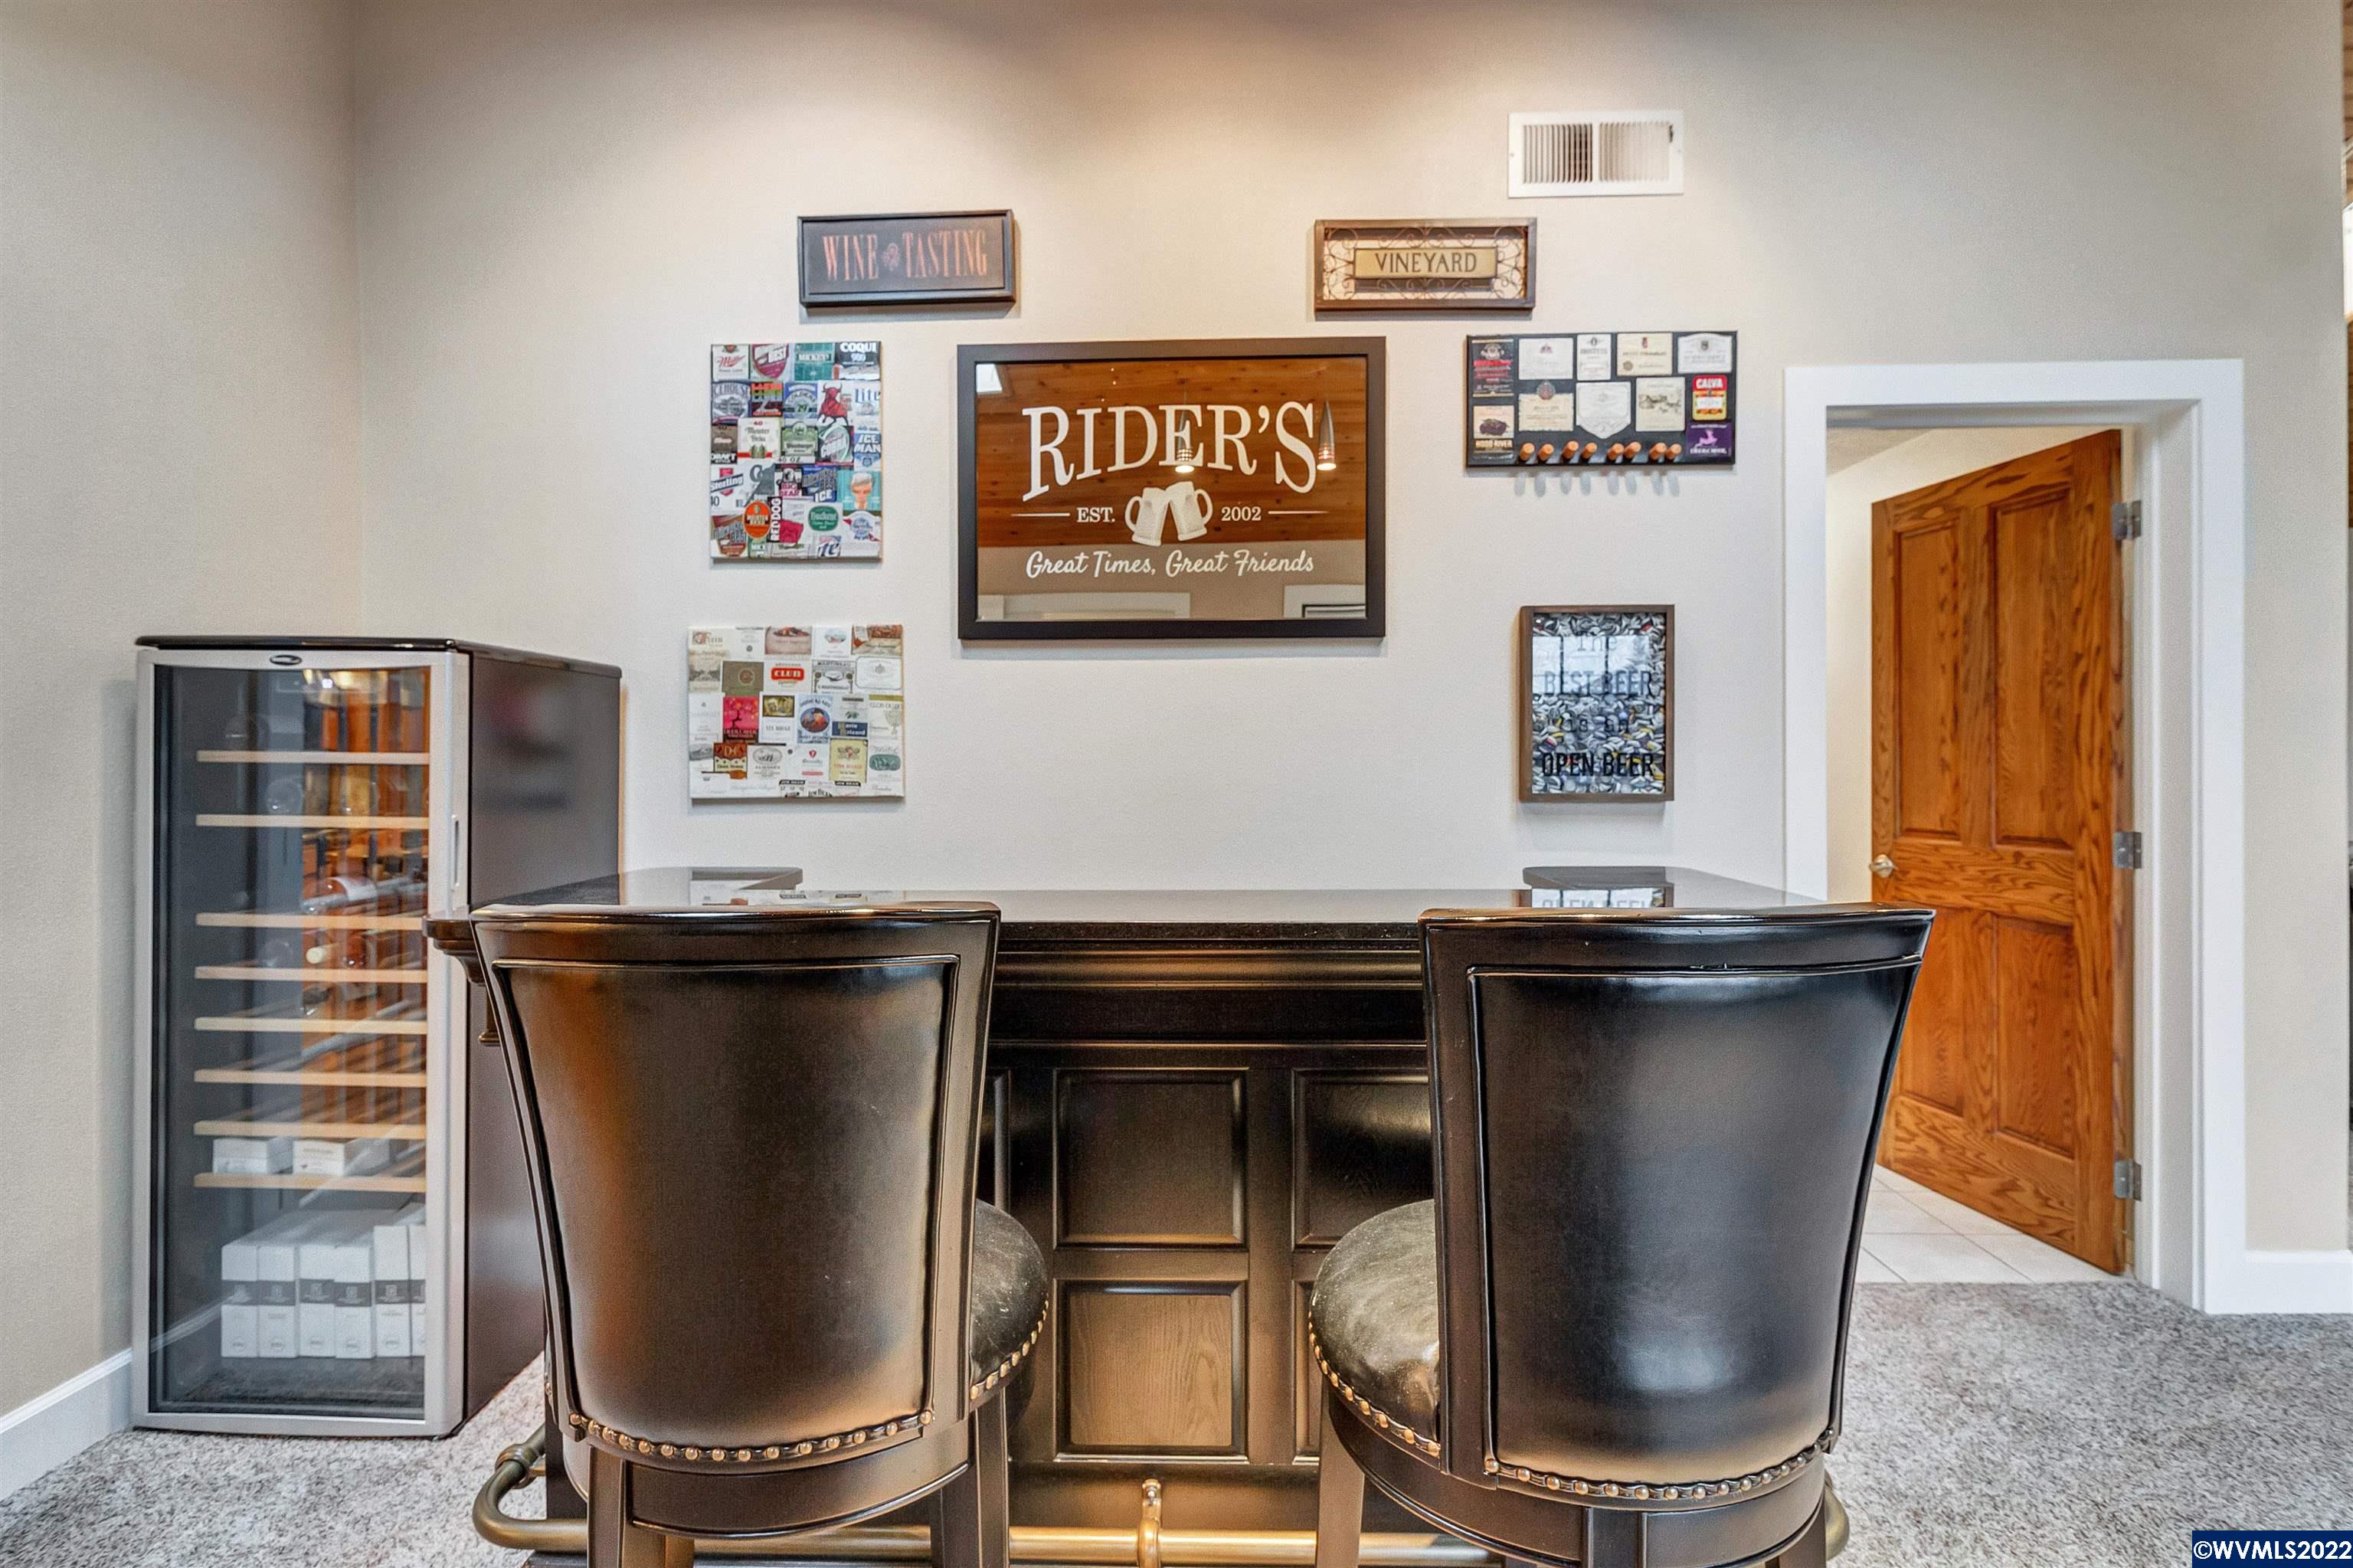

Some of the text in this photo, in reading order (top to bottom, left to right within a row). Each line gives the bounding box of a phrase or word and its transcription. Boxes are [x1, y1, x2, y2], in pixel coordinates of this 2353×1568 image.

[823, 229, 987, 281] WINE TASTING
[1375, 252, 1478, 273] VINEYARD
[840, 342, 877, 352] COQUI
[1696, 378, 1723, 389] CALVA
[855, 388, 881, 404] Lite
[858, 434, 878, 444] ICE
[1494, 440, 1513, 448] RIVER
[854, 444, 881, 453] MAN
[1021, 401, 1317, 502] RIDER'S
[814, 489, 832, 502] ICE
[771, 497, 781, 522] DOG
[1076, 506, 1262, 524] EST. 2002
[1026, 549, 1314, 579] Great Times, Great Friends
[774, 669, 800, 678] CLUB
[1543, 670, 1653, 698] BEST BEER
[1541, 751, 1654, 777] OPEN BEER
